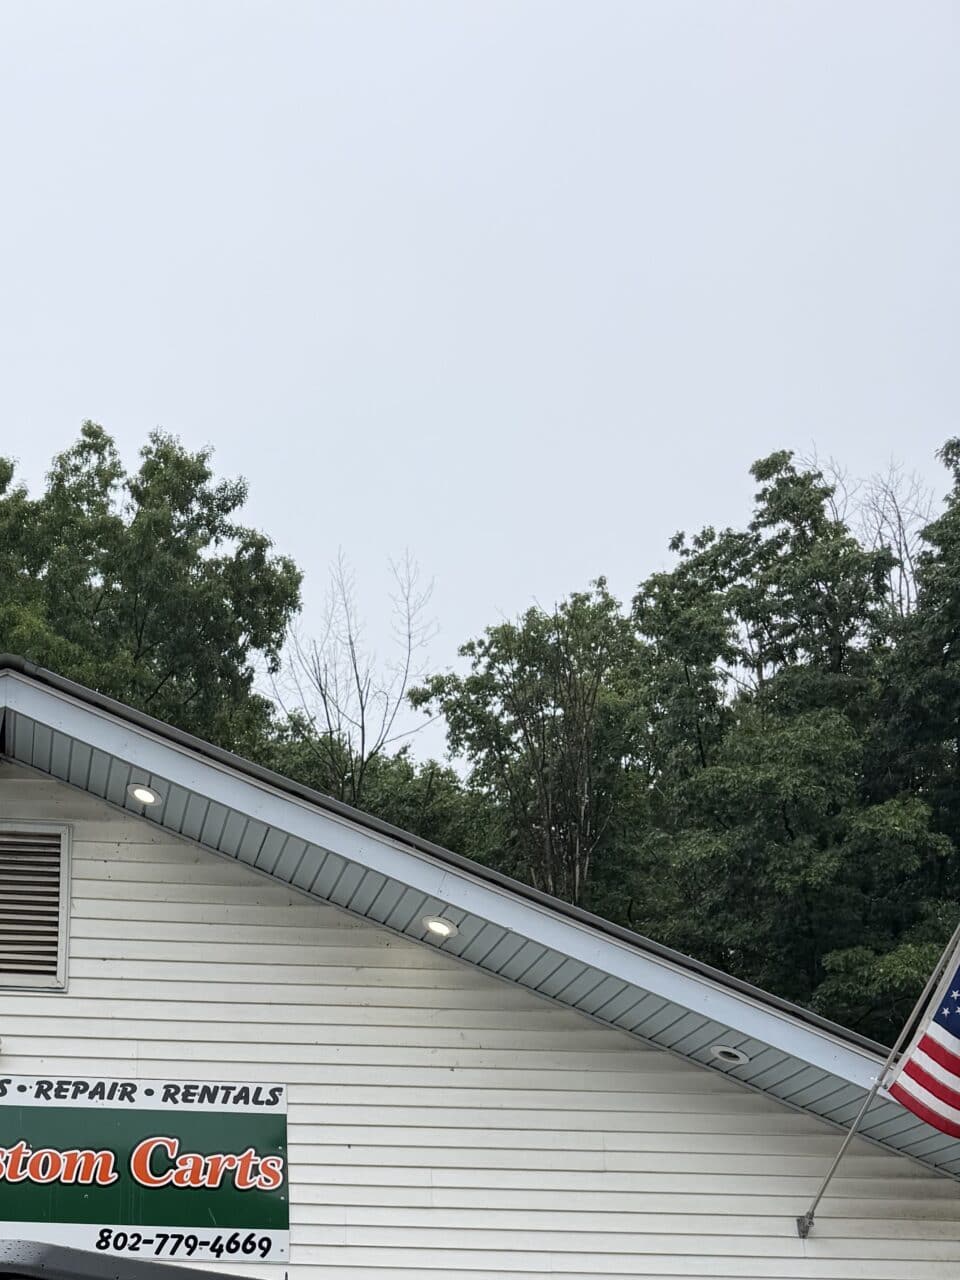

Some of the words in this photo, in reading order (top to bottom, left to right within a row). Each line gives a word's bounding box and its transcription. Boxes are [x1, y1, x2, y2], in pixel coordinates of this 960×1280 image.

[34, 1079, 138, 1102] REPAIR
[161, 1084, 283, 1106] RENTALS
[131, 1136, 284, 1190] Carts
[95, 1228, 272, 1258] 802-779-4669
